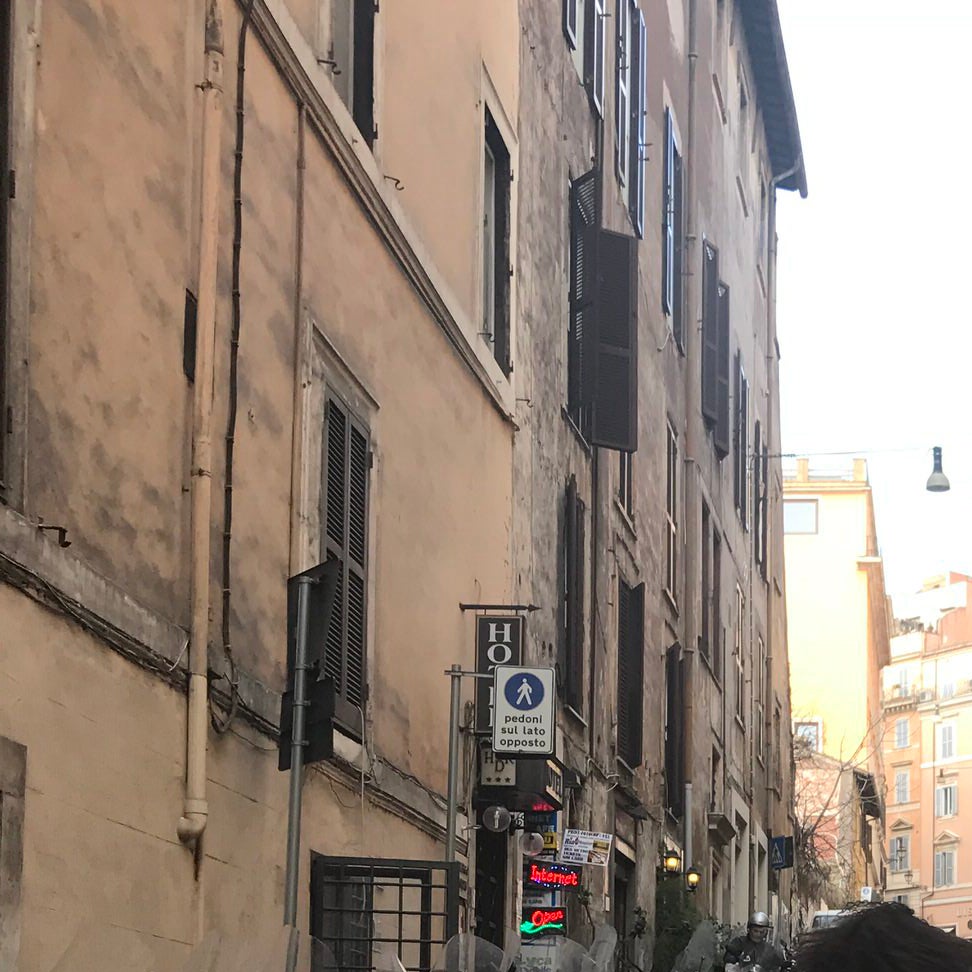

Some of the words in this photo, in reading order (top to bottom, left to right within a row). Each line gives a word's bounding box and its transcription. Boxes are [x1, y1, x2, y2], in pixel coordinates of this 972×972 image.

[504, 714, 543, 724] pedoni
[501, 726, 518, 735] sul
[523, 726, 546, 735] lato
[499, 738, 546, 747] opposto
[531, 865, 578, 886] Internet
[532, 910, 563, 927] Open
